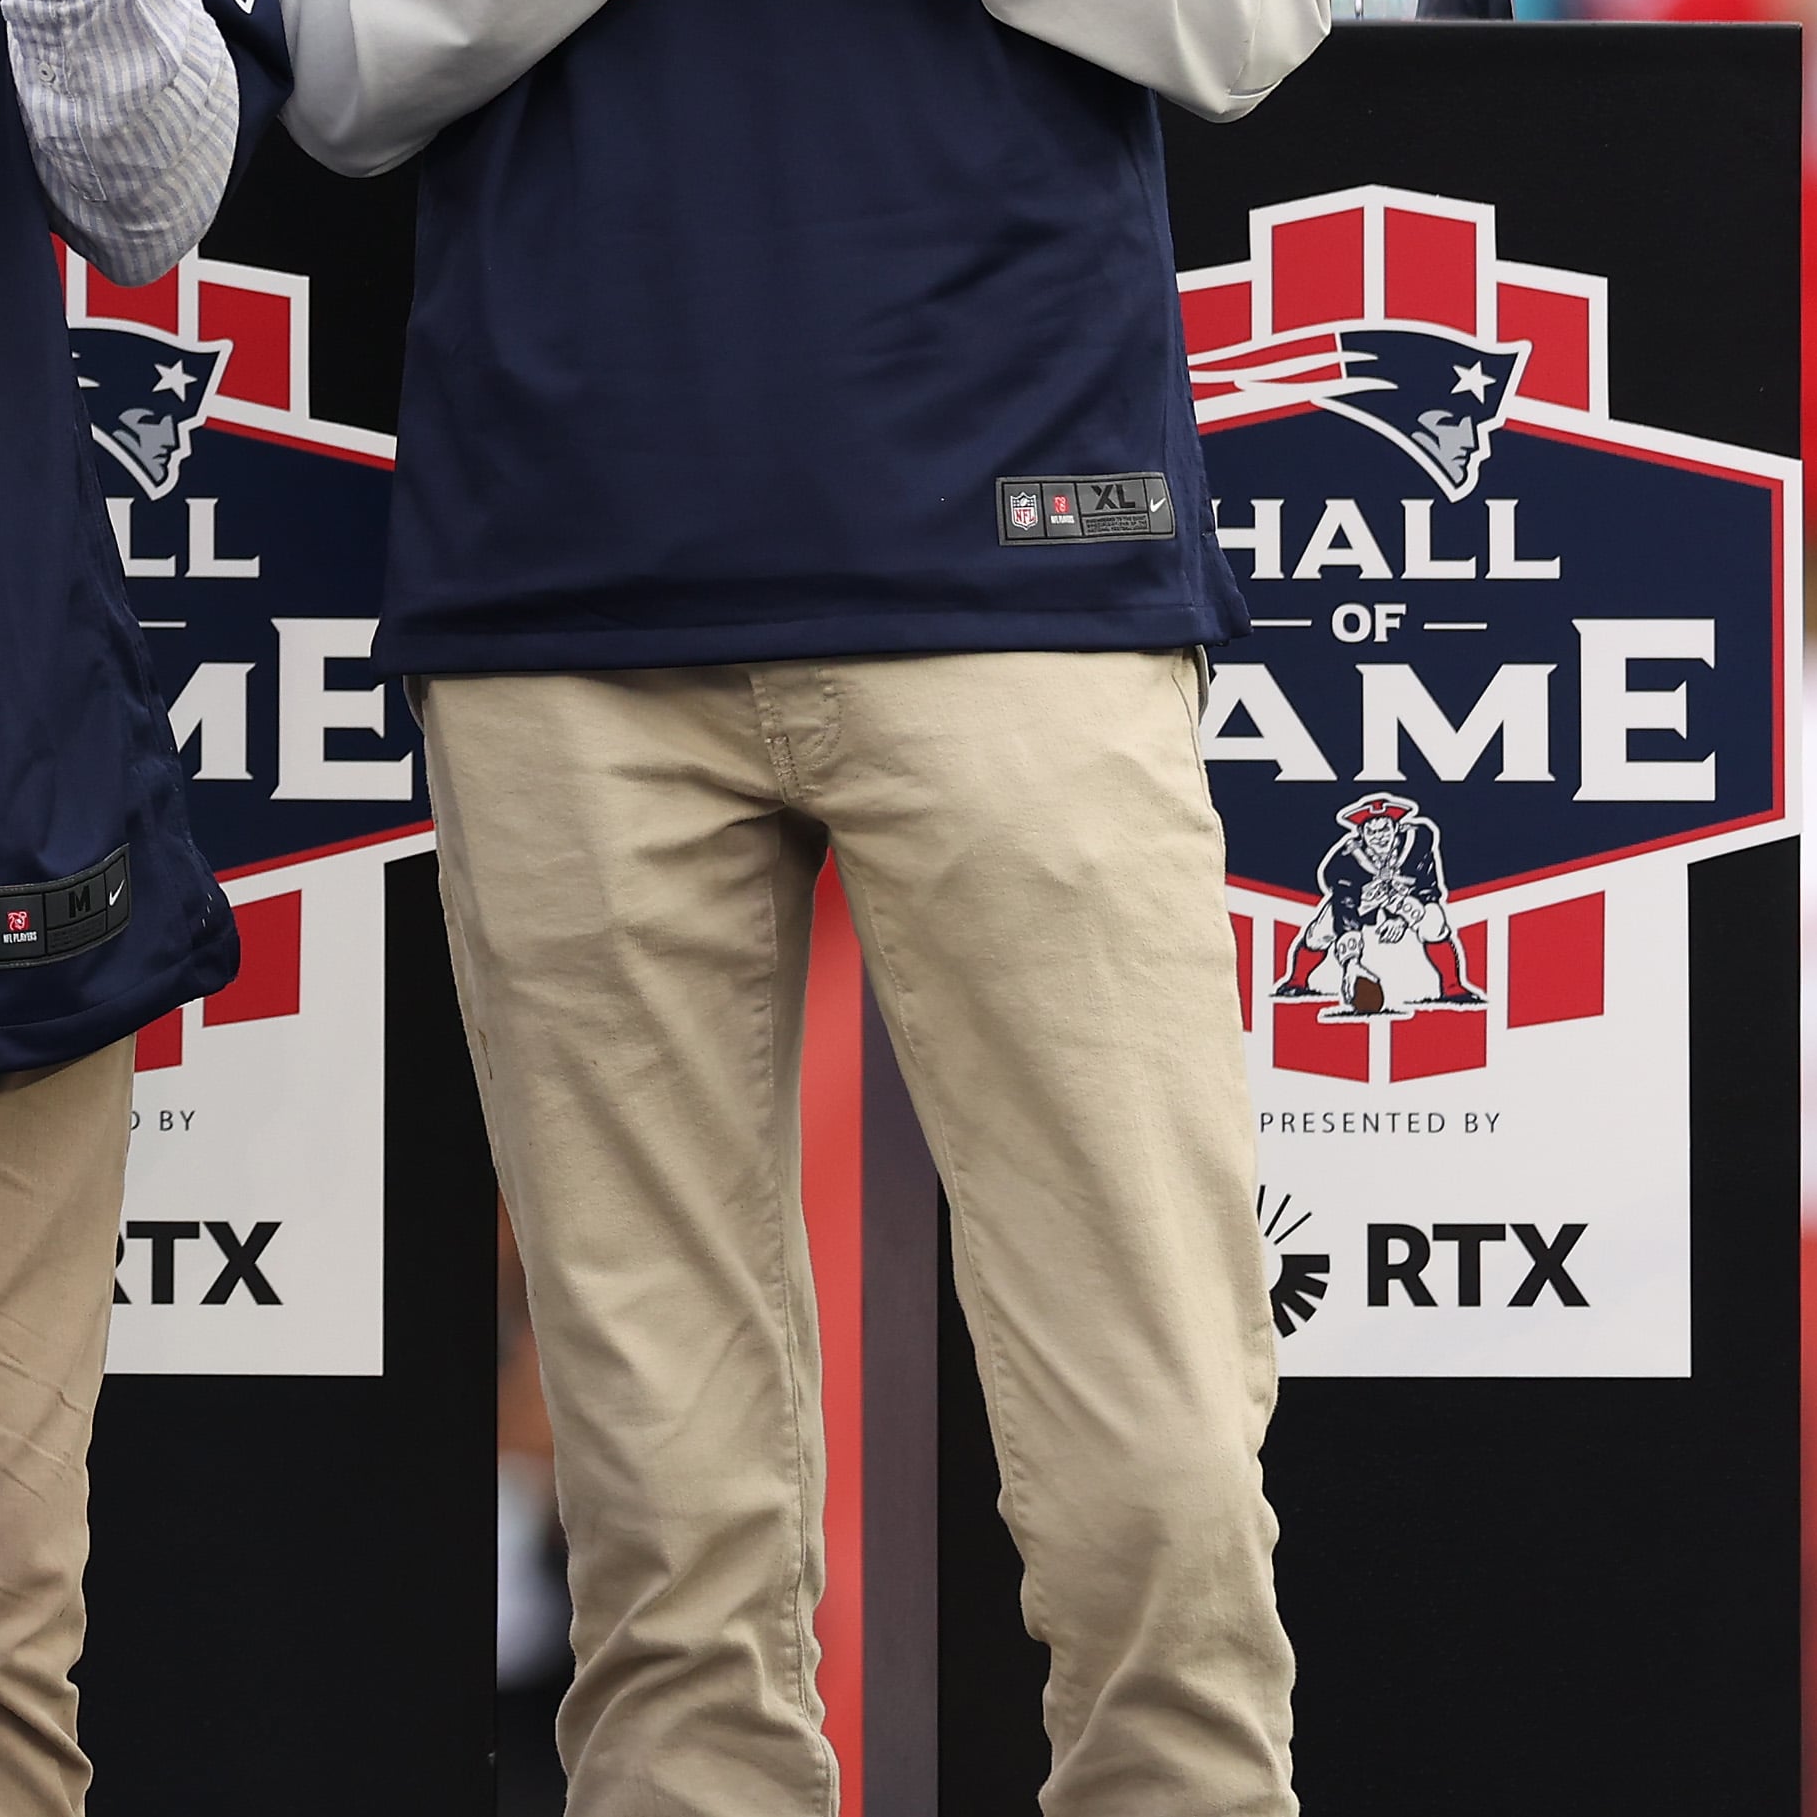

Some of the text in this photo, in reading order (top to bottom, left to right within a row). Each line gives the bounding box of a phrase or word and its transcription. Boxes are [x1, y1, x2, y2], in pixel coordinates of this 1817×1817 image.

[1090, 483, 1136, 511] XL
[1013, 507, 1036, 525] NFL
[1211, 498, 1561, 580] HALL
[1330, 602, 1407, 643] OF
[1199, 617, 1716, 802] AME
[68, 884, 91, 919] M
[159, 1110, 195, 1132] BY
[1260, 1112, 1501, 1134] PRESENTED BY
[1367, 1223, 1590, 1307] RTX
